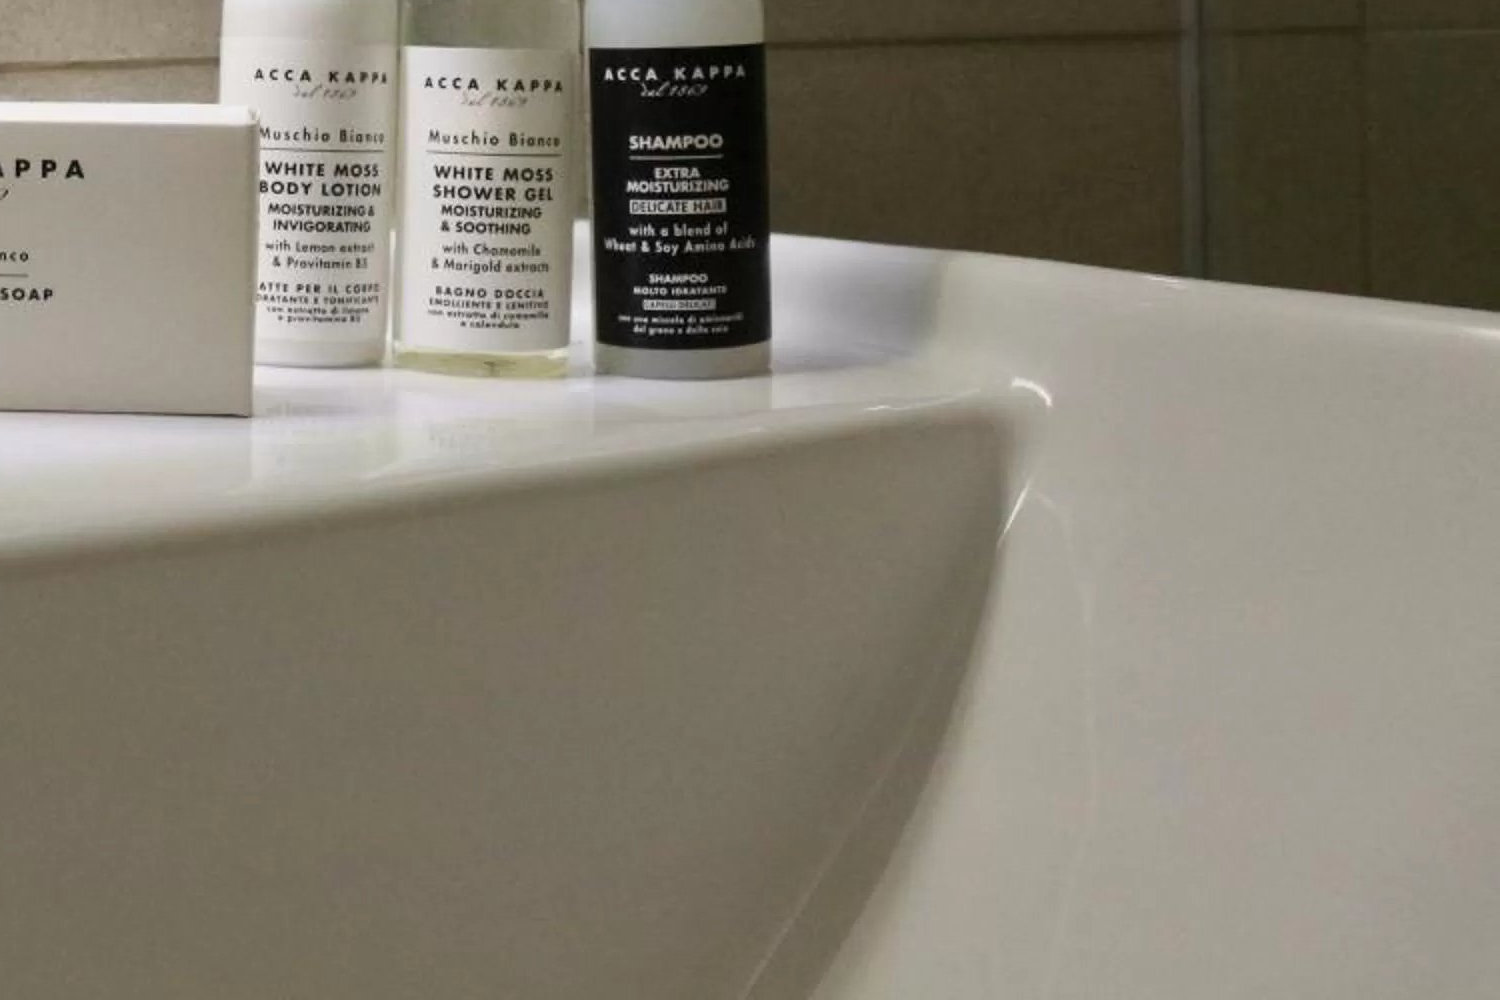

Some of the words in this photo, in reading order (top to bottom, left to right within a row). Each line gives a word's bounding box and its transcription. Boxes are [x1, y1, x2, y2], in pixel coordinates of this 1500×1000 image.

[254, 68, 312, 82] ACCA
[328, 71, 387, 84] KAPPA
[604, 67, 658, 81] ACCA
[674, 64, 746, 80] KAPPA
[424, 76, 479, 90] ACCA
[496, 78, 563, 93] KAPPA
[260, 126, 331, 142] Muschio
[339, 128, 385, 143] Bianco
[428, 129, 499, 146] Muschio
[509, 132, 560, 147] Bianco
[628, 134, 724, 149] SHAMPOO
[265, 161, 325, 177] WHITE
[333, 163, 379, 178] MOSS
[434, 165, 494, 181] WHITE
[503, 167, 553, 182] MOSS
[654, 167, 701, 179] EXTRA
[259, 180, 313, 195] BODY
[321, 183, 381, 197] LOTION
[433, 184, 516, 200] SHOWER
[525, 187, 553, 201] GEL
[626, 179, 730, 193] MOISTURIZING
[268, 203, 366, 217] MOISTURIZING
[441, 205, 542, 218] MOISTURIZING
[631, 201, 689, 213] DELICATE
[693, 200, 723, 212] HAIR
[273, 220, 371, 233] INVIGORATING
[441, 220, 450, 232] &
[456, 221, 531, 234] SOOTHING
[628, 223, 656, 237] with
[660, 227, 669, 237] a
[673, 221, 711, 237] blend
[295, 241, 336, 253] Lemon
[442, 241, 468, 254] with
[474, 243, 541, 256] Chamomile
[641, 240, 650, 253] &
[655, 240, 679, 256] Soy
[685, 239, 725, 252] Amino
[444, 259, 501, 274] Marigold
[649, 273, 709, 284] SHAMPOO
[0, 287, 54, 301] SOAP
[259, 282, 288, 292] ATTE
[436, 285, 487, 298] BAGNO
[494, 288, 544, 298] DOCCIA
